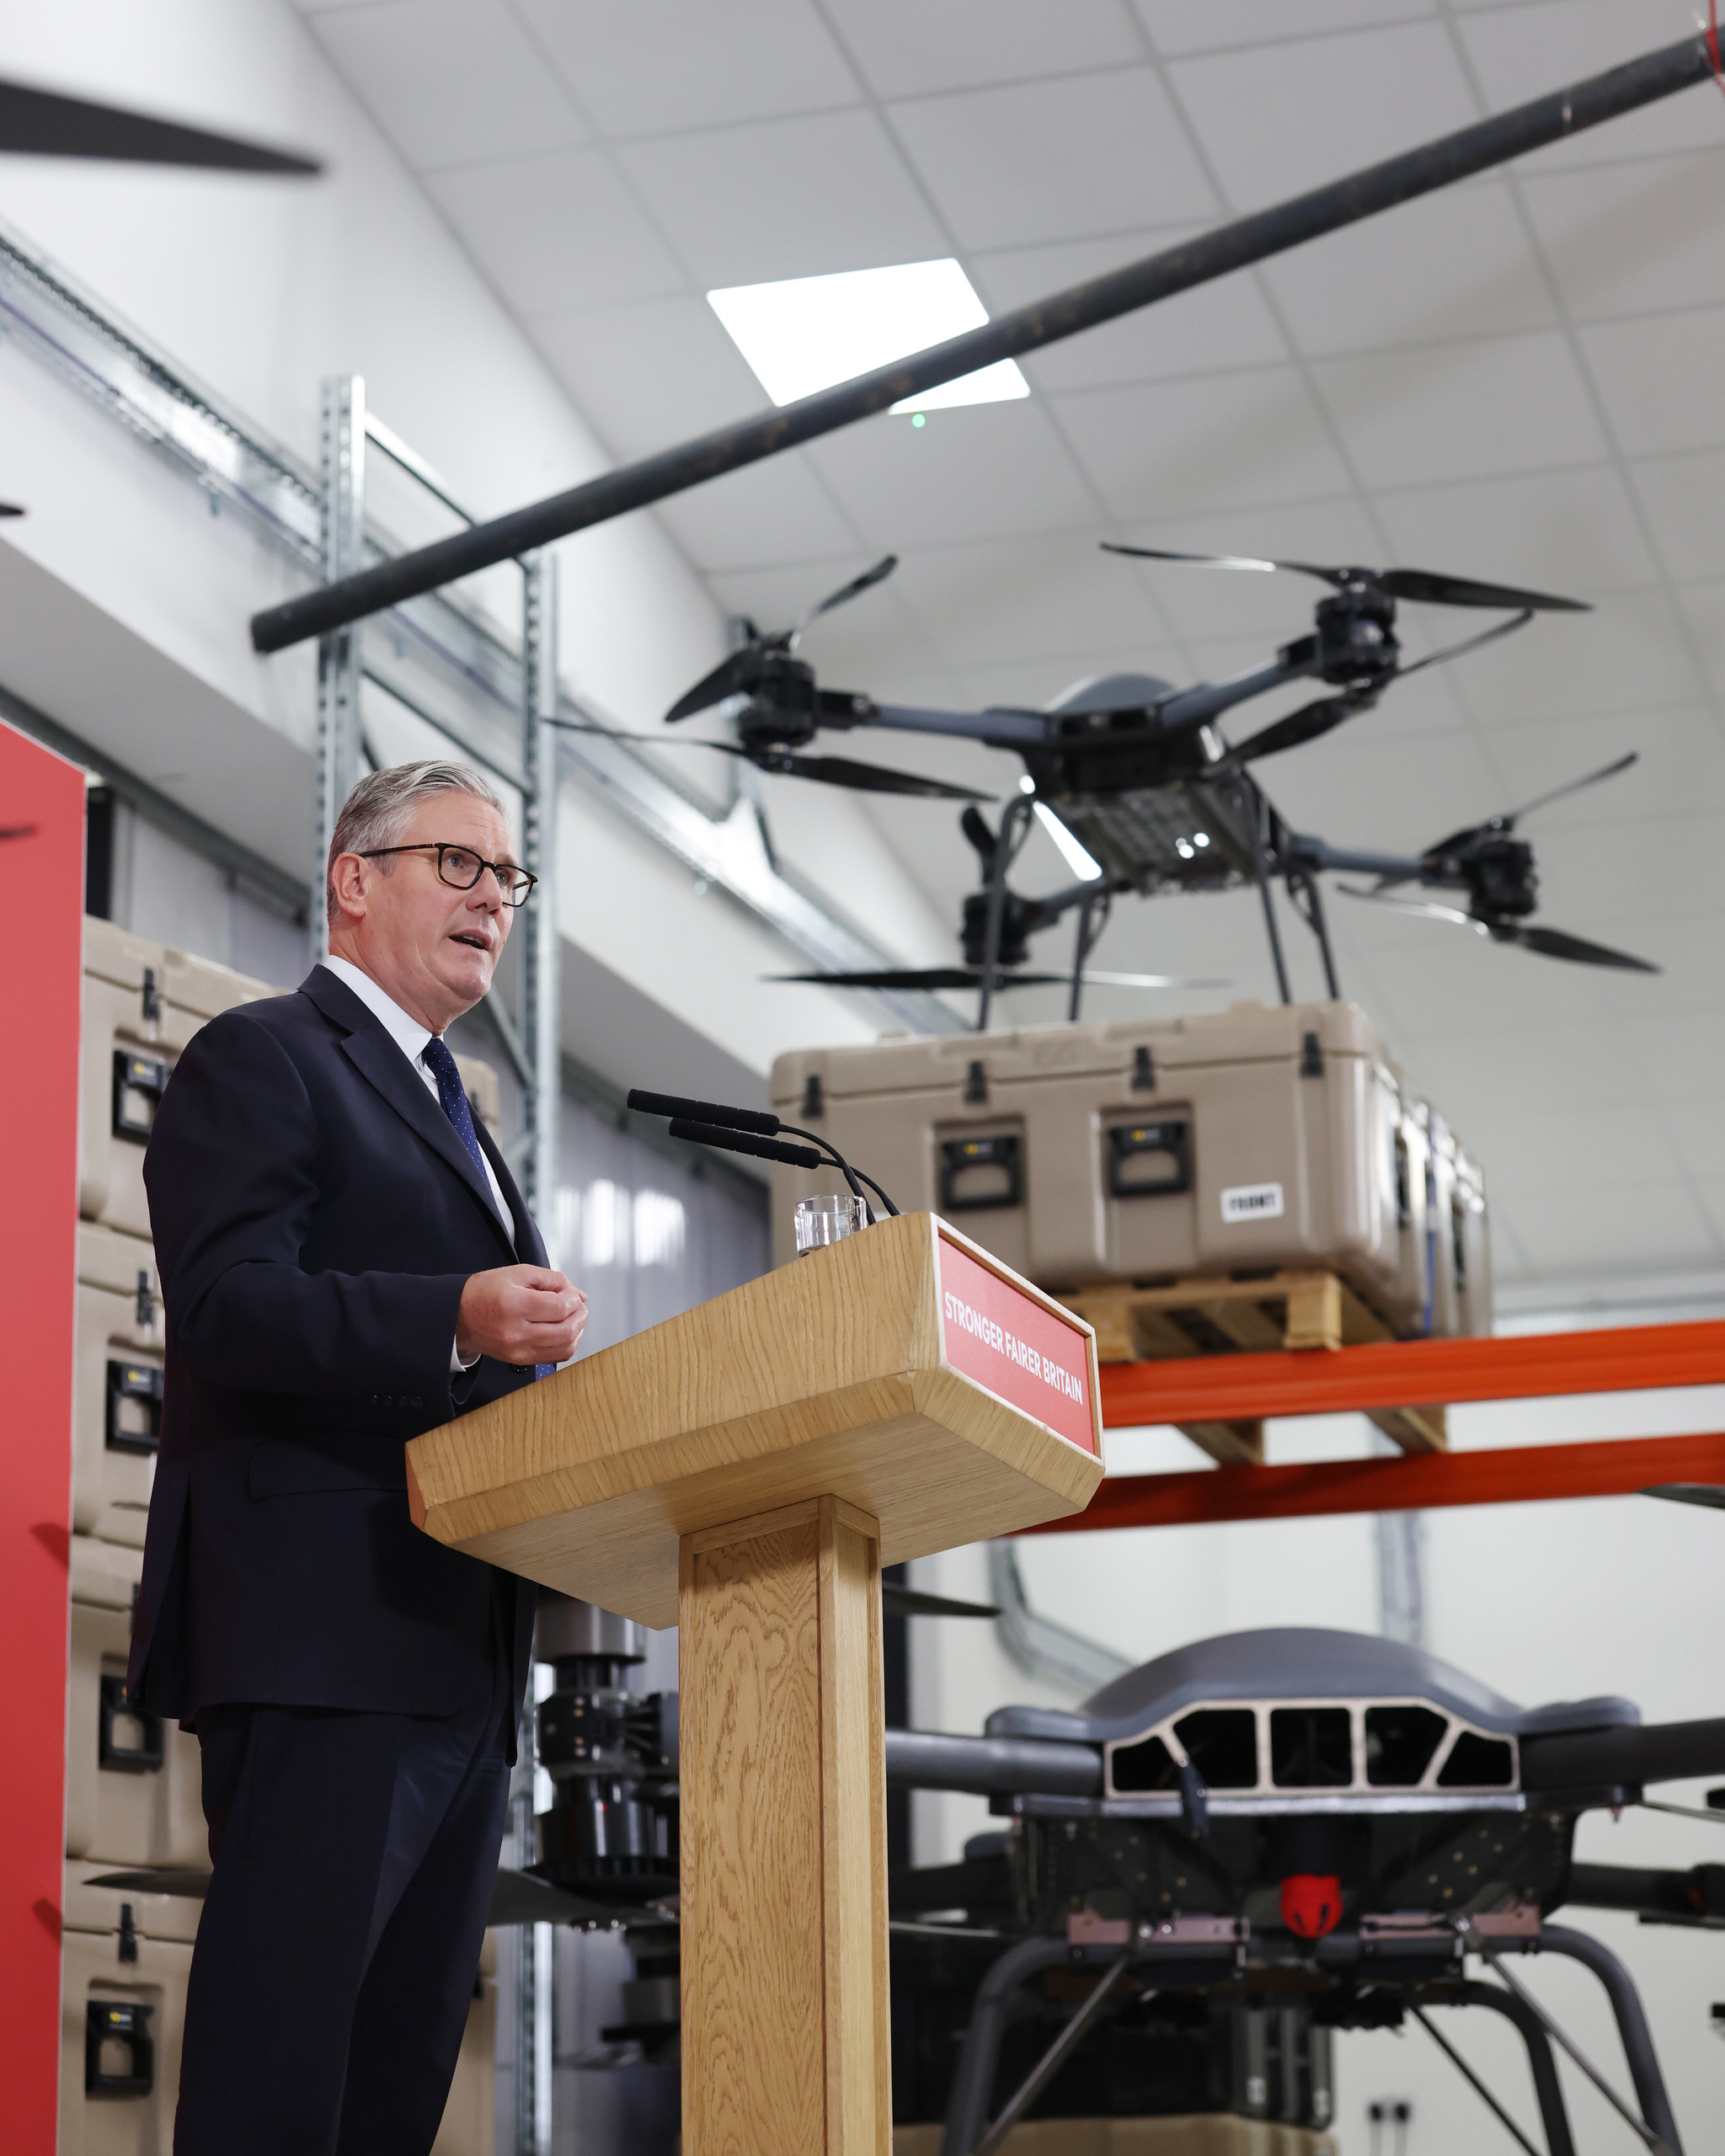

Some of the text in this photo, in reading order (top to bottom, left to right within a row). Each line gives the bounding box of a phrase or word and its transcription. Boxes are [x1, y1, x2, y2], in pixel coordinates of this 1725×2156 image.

[944, 1291, 1083, 1406] STRONGER FAIRER BRITAIN
